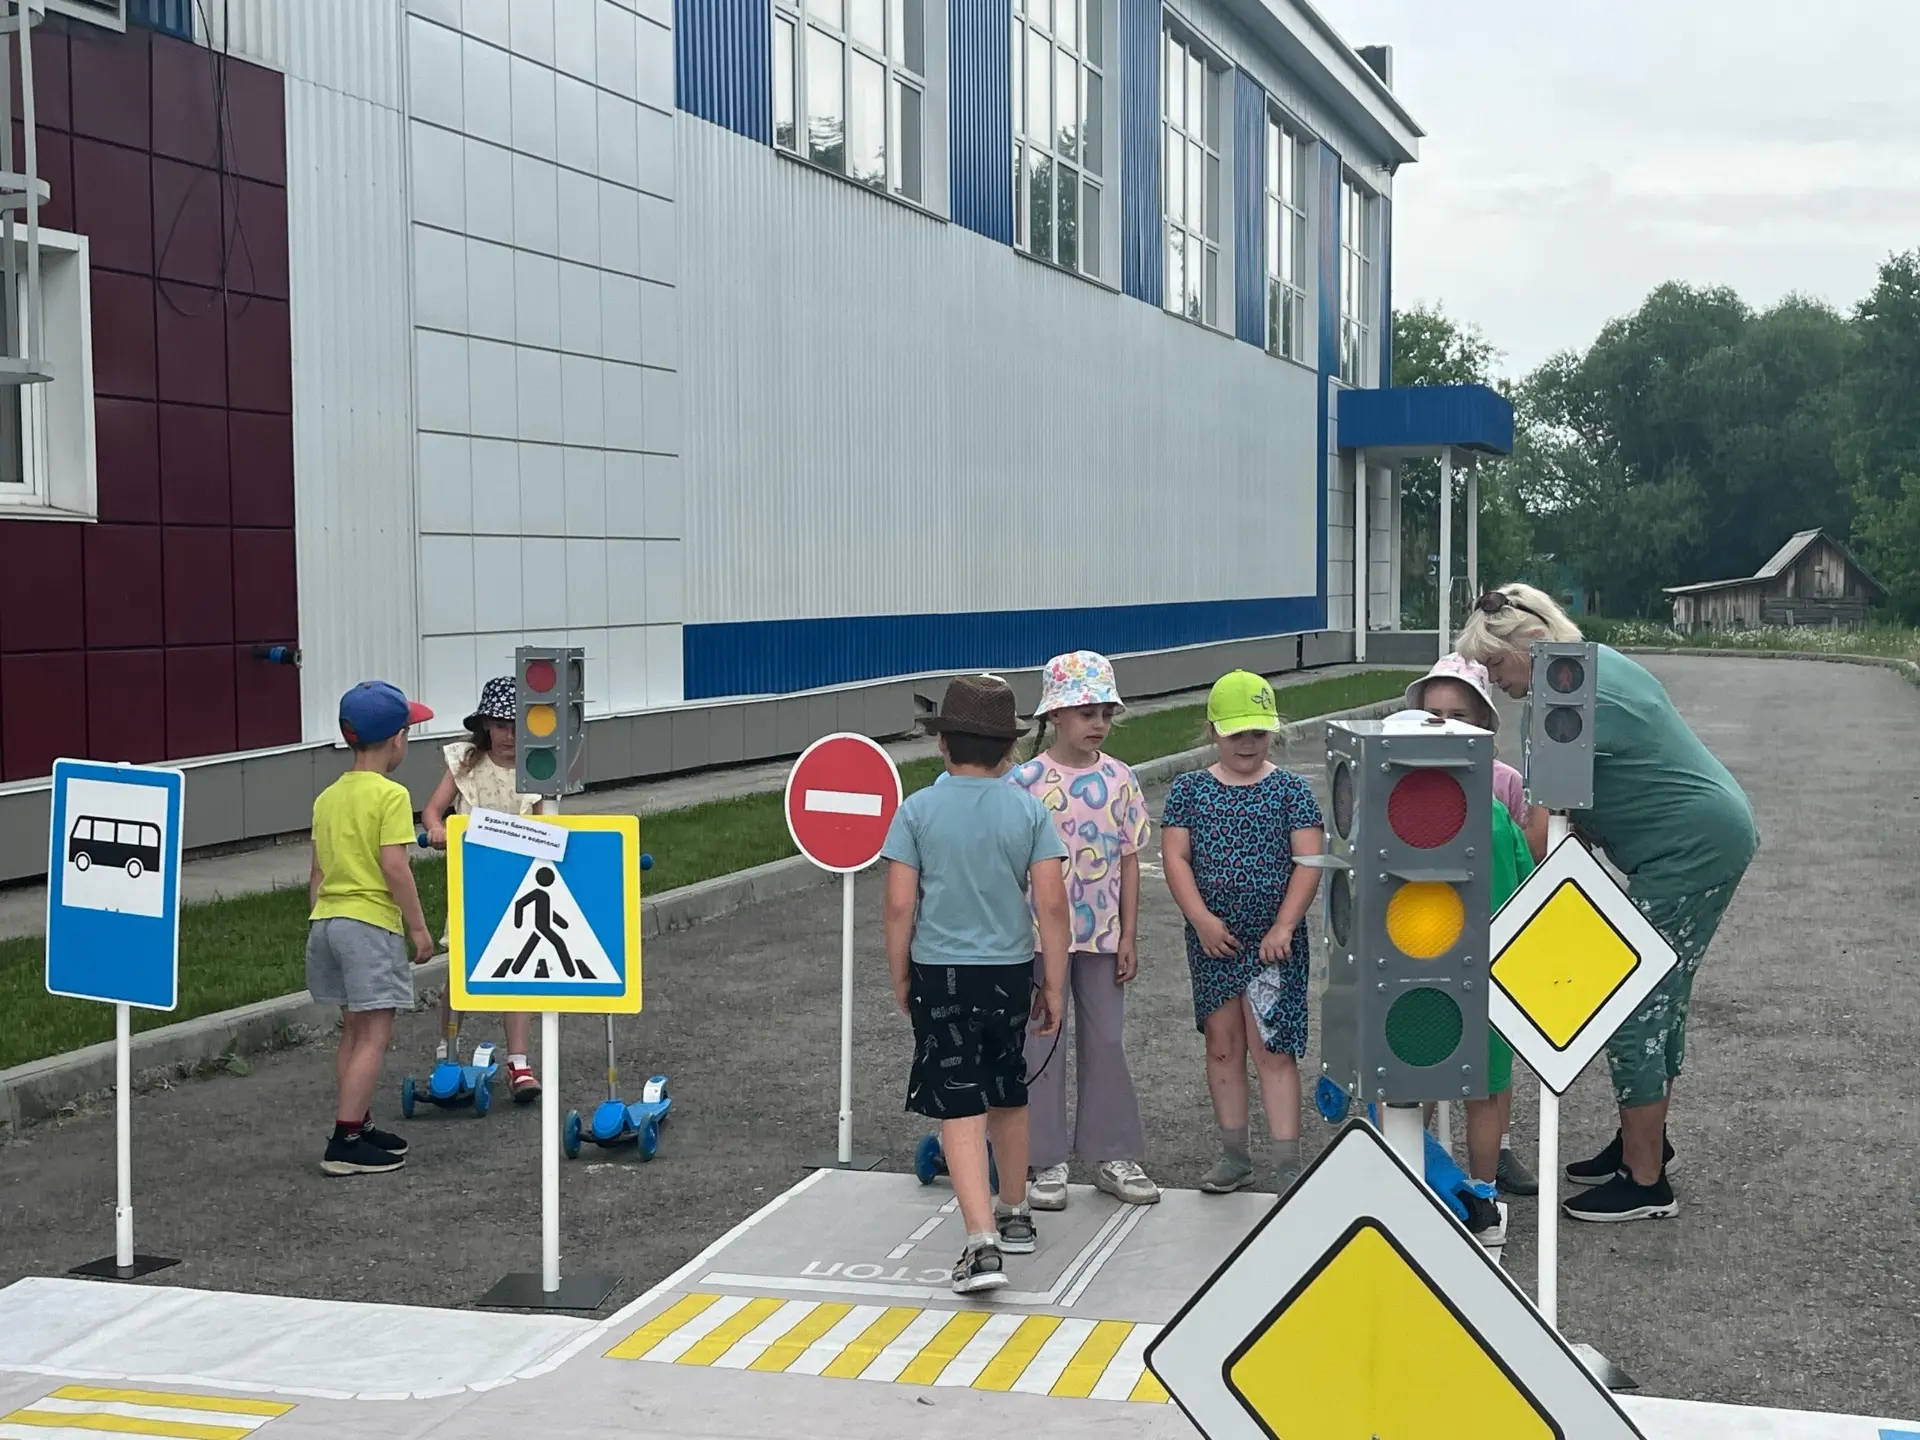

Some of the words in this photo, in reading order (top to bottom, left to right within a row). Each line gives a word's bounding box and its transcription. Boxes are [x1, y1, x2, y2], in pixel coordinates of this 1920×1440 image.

[484, 816, 509, 826] Будьте
[510, 821, 547, 835] бдительны
[484, 826, 520, 837] пешеходы
[800, 1260, 953, 1283] СТОП
